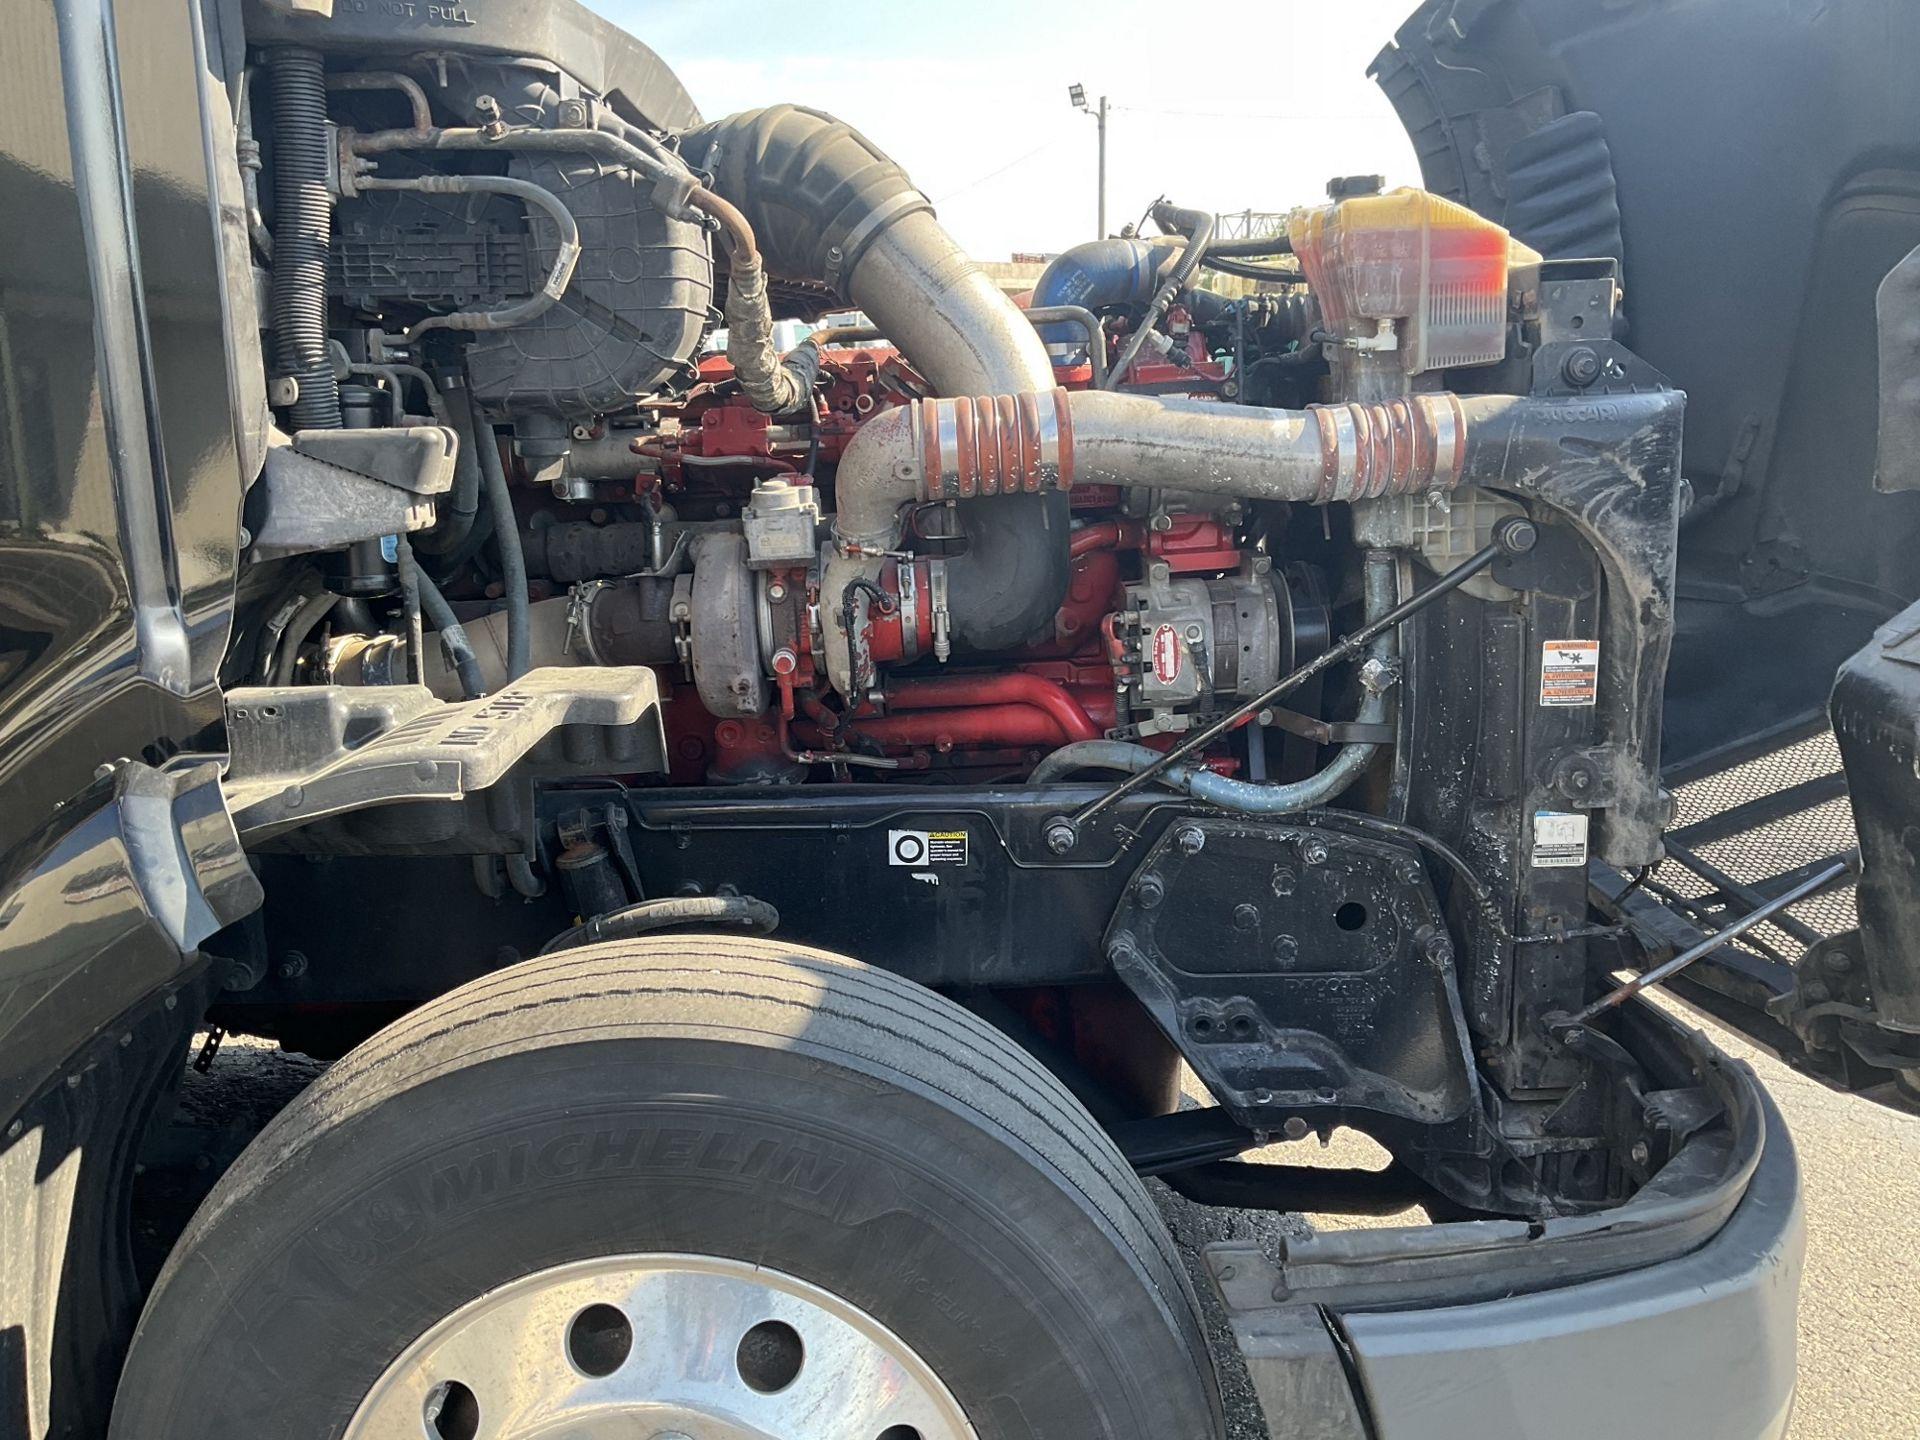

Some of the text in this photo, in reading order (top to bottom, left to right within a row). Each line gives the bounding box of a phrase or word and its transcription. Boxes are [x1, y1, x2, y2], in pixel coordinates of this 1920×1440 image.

[341, 0, 477, 24] DO NOT PULL
[438, 691, 535, 745] NO STEP
[431, 1127, 848, 1207] MICHELIN
